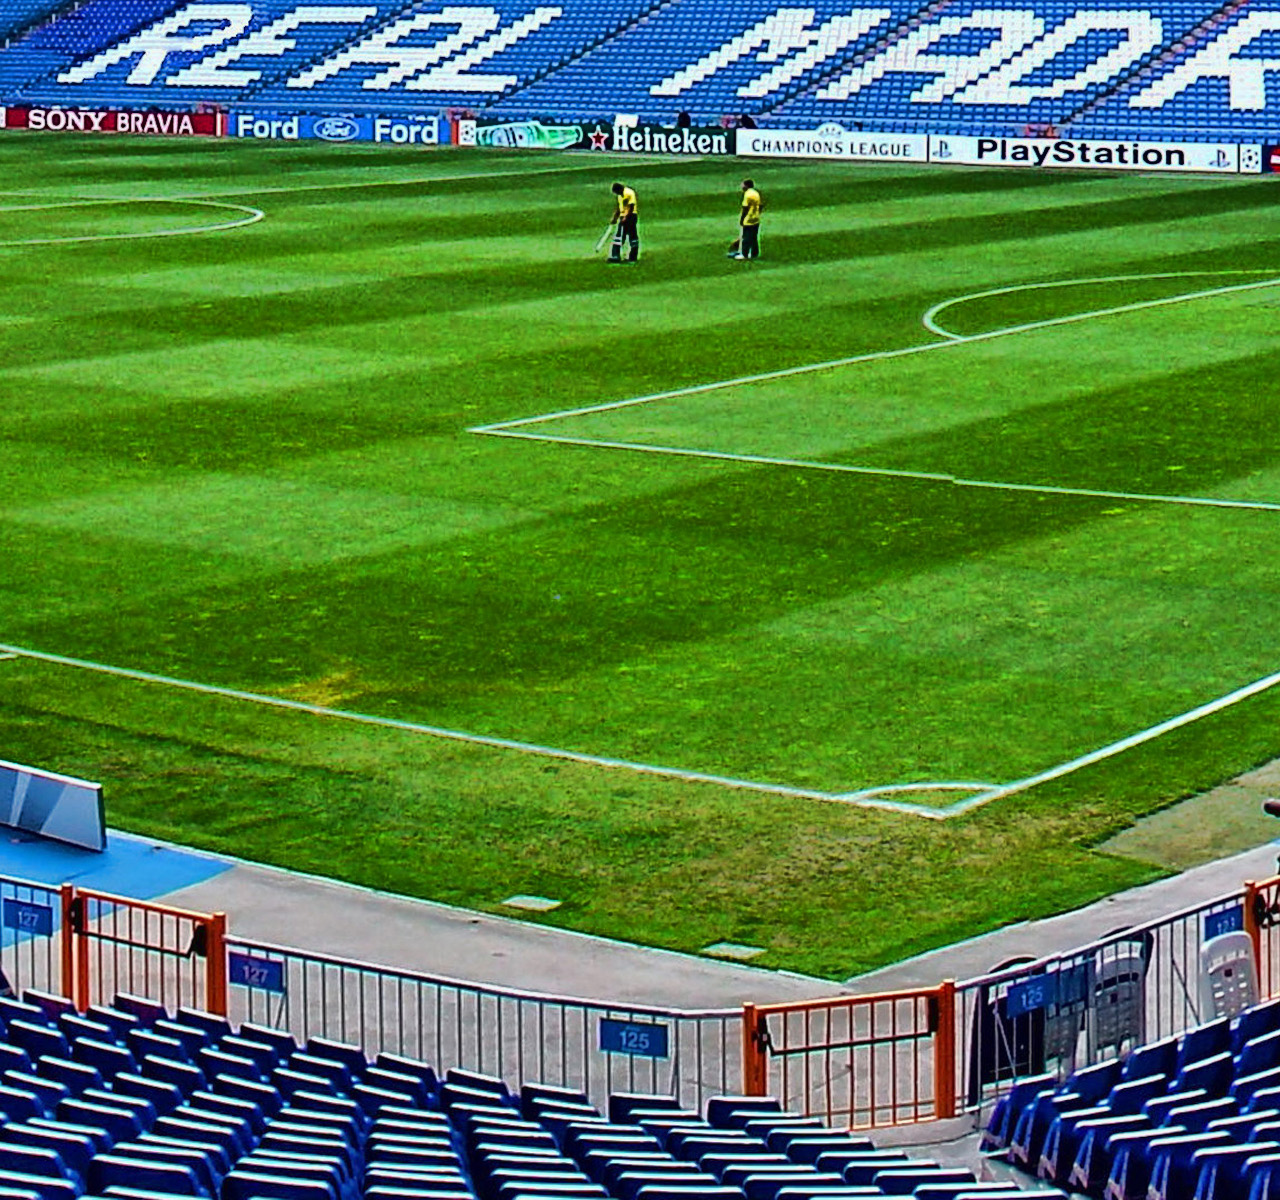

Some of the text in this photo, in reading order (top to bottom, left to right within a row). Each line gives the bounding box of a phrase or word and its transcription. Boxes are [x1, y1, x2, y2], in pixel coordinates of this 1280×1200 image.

[57, 4, 562, 92] REAL
[28, 108, 195, 135] SONY BRAVIA
[237, 115, 299, 139] Ford
[374, 117, 439, 143] Ford
[612, 126, 727, 154] Heineken
[752, 138, 911, 157] CHAMPIONS LEAGUE
[977, 139, 1185, 167] PlayStation
[17, 910, 39, 927] 127
[243, 965, 268, 981] 127
[620, 1031, 650, 1049] 125
